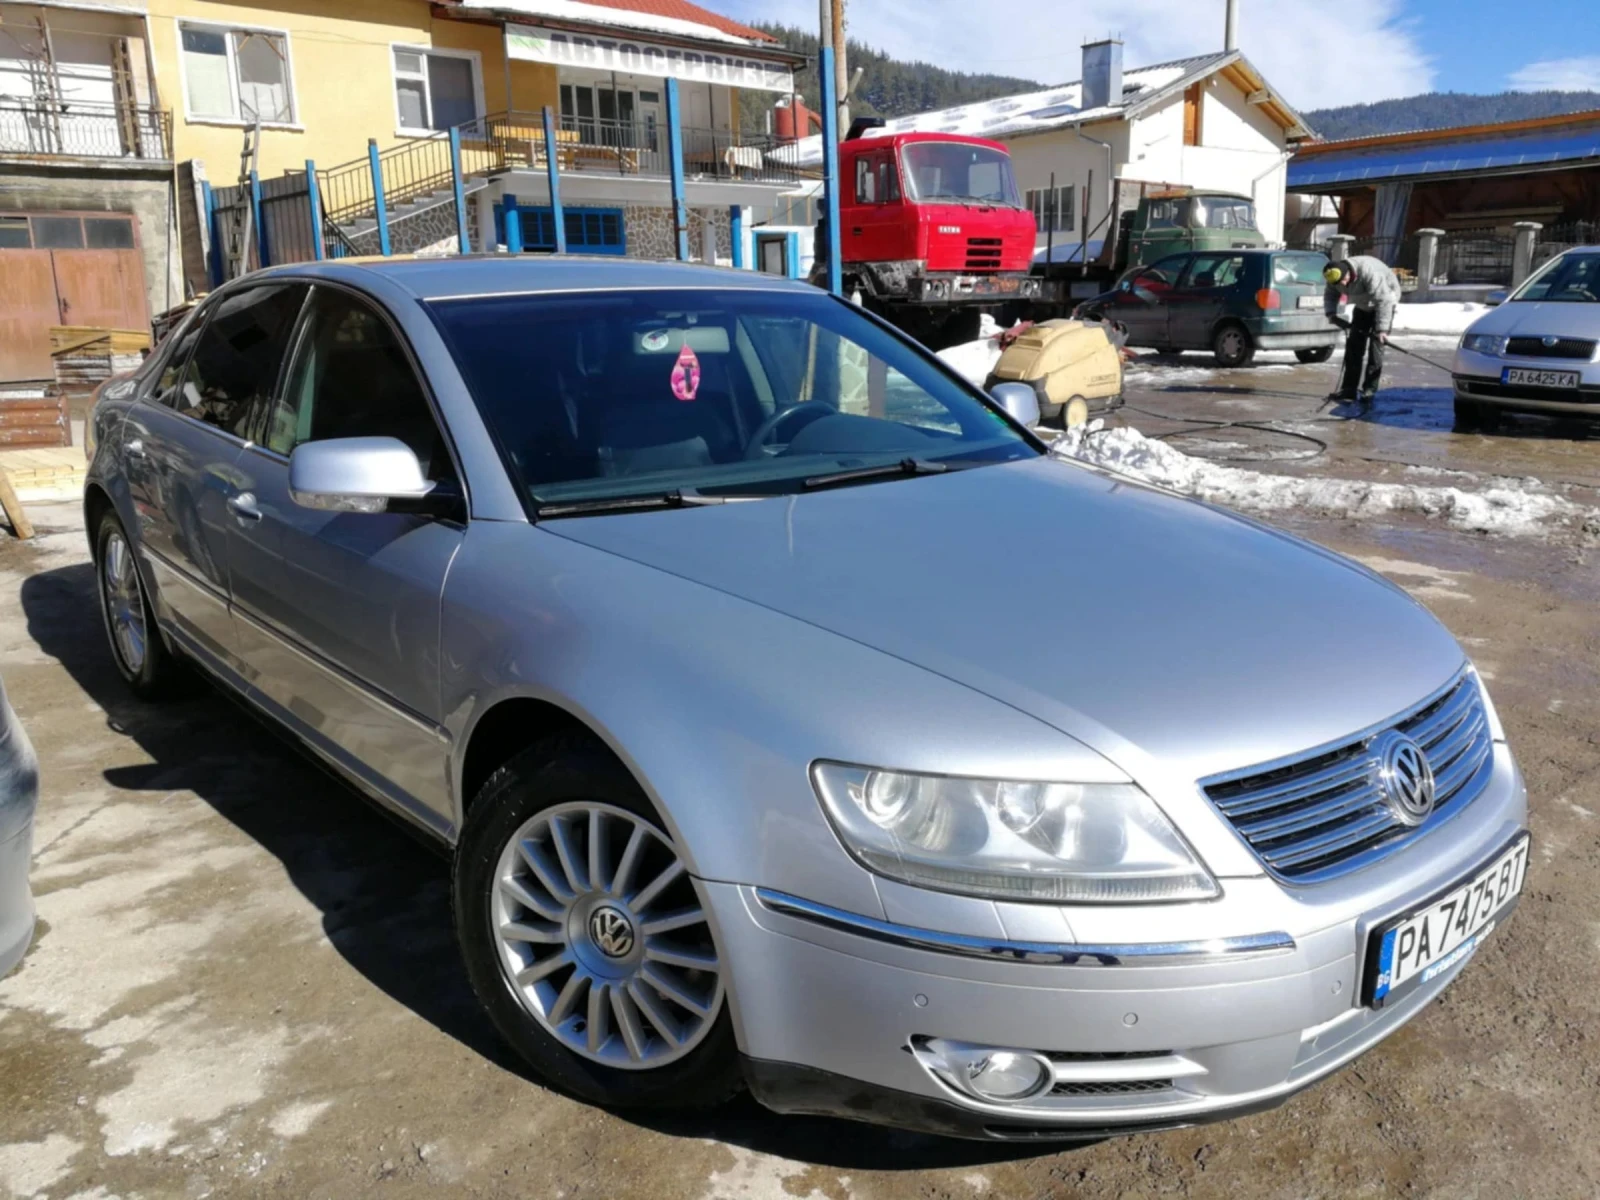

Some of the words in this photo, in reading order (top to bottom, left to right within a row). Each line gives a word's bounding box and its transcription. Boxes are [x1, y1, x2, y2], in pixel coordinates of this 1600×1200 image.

[549, 33, 765, 85] АВТОСЕРВИЗ
[1509, 371, 1525, 383] PA
[1527, 372, 1557, 384] 6425
[1558, 375, 1576, 387] KA
[1396, 915, 1431, 980] PA
[1438, 871, 1497, 953] 7475
[1496, 846, 1527, 907] BT
[1377, 971, 1391, 989] BG
